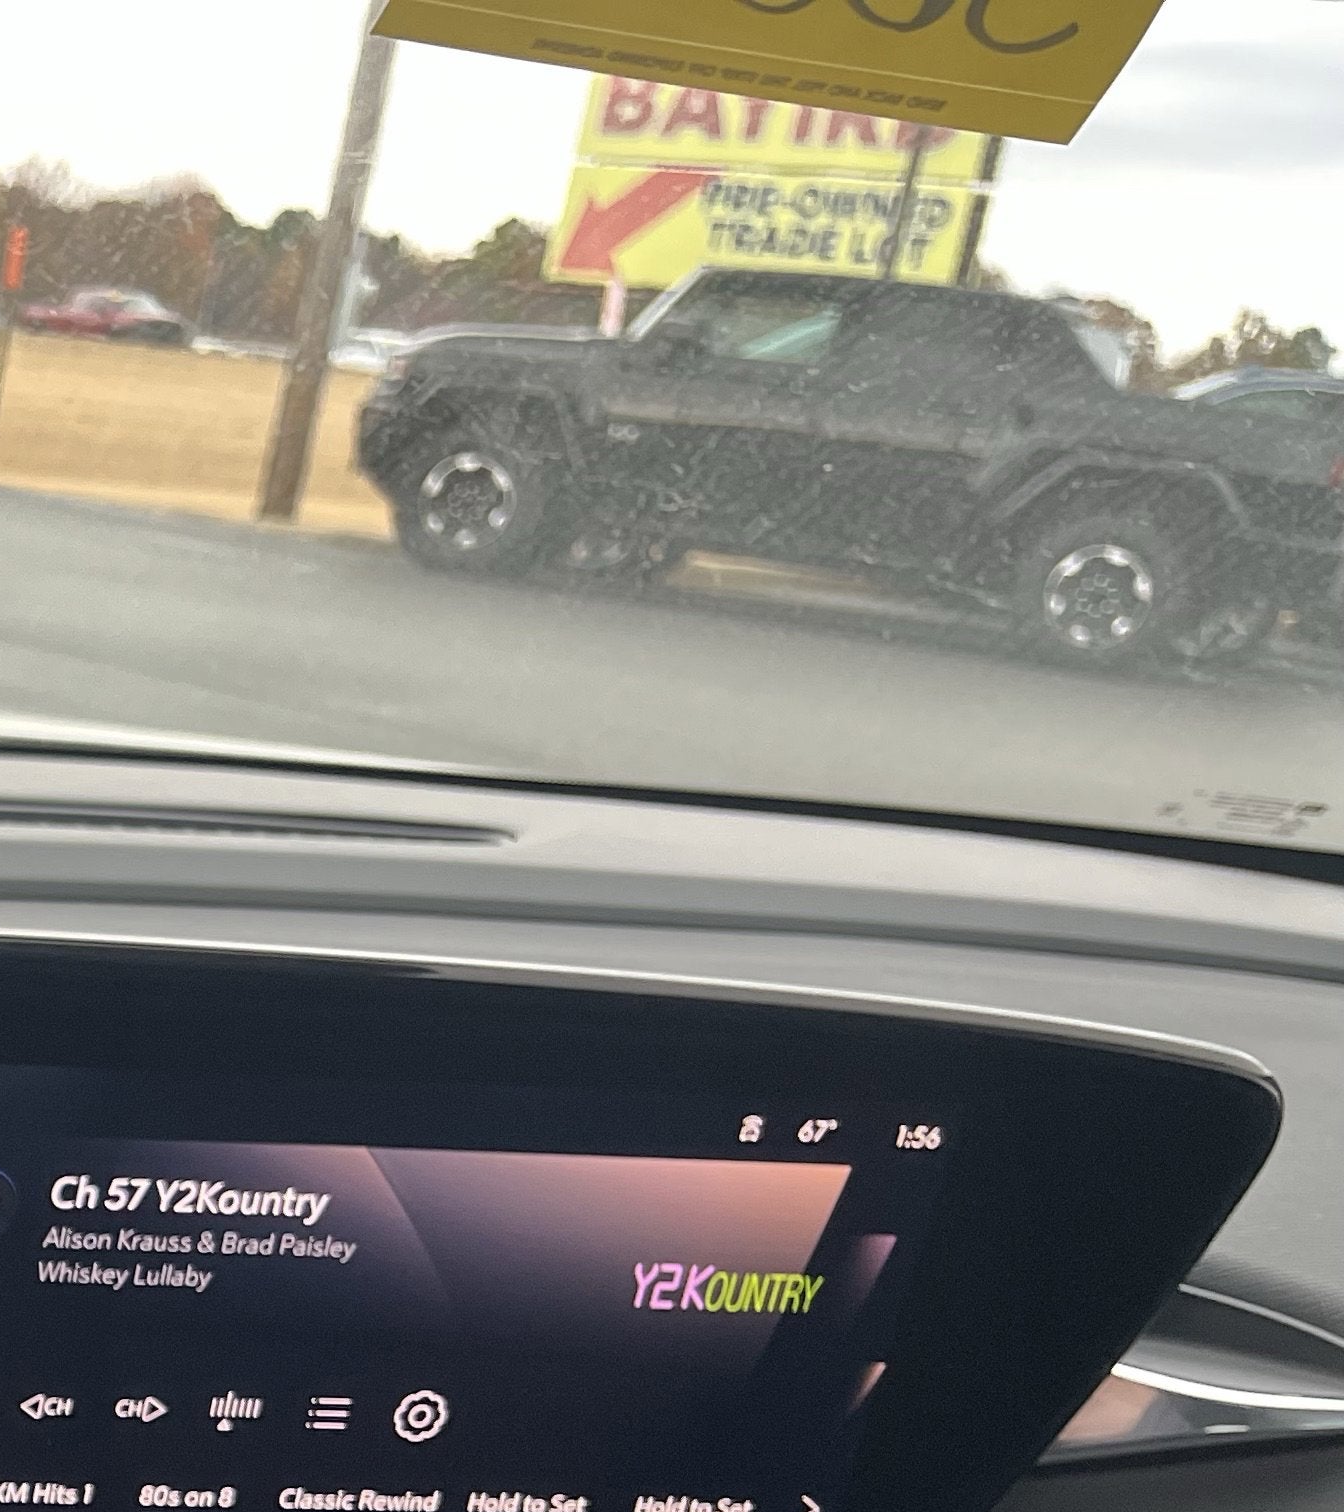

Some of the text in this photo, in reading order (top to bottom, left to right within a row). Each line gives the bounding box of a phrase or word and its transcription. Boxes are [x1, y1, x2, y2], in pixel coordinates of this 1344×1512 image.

[709, 221, 836, 262] TRADE
[896, 1125, 942, 1150] 1:56
[50, 1175, 332, 1226] Ch 57 Y2Kountry
[42, 1226, 357, 1263] Alison Krauss & Brad Paisley
[38, 1260, 213, 1292] Whiskey Lullaby
[633, 1262, 824, 1314] Y2KOUNTRY
[32, 1482, 77, 1505] Hits
[138, 1484, 180, 1507] 80s
[184, 1489, 216, 1508] on
[278, 1486, 442, 1512] Classic Rewind
